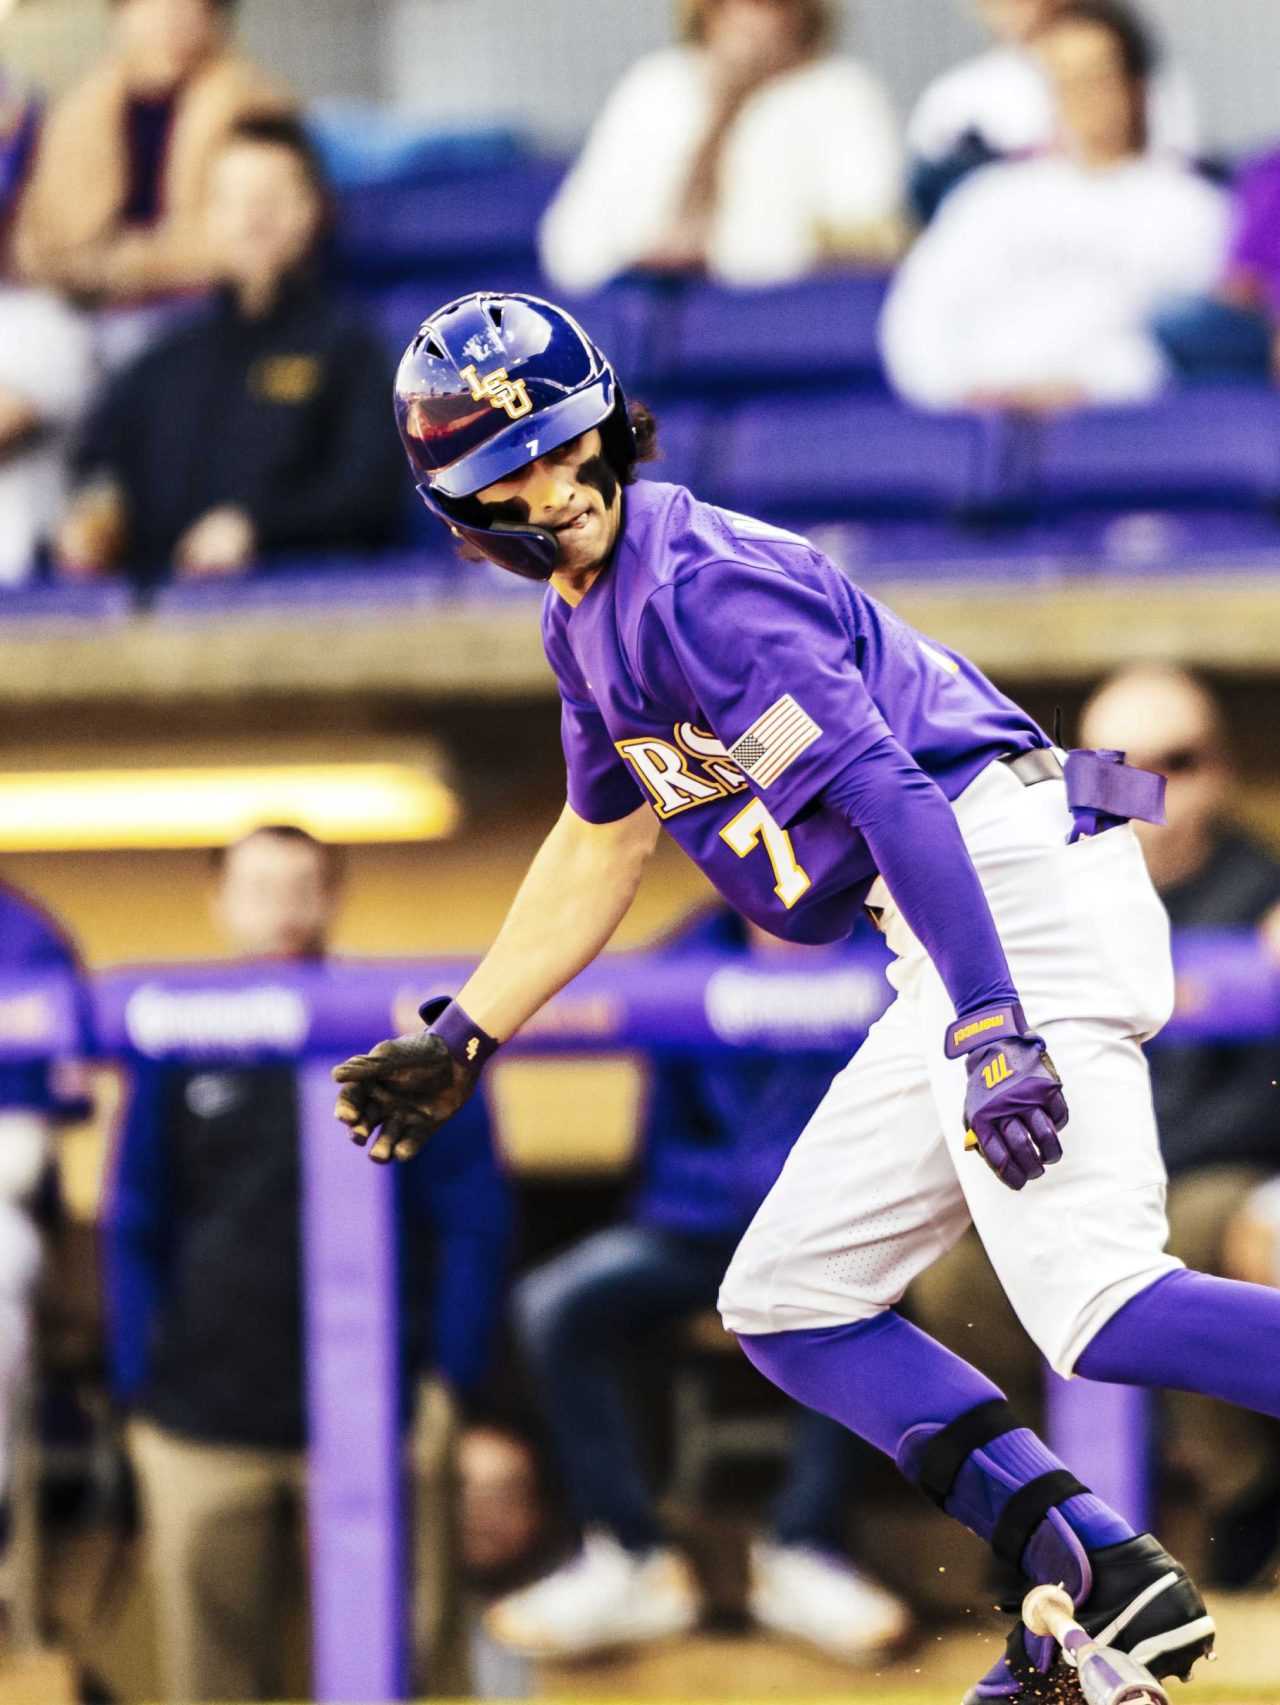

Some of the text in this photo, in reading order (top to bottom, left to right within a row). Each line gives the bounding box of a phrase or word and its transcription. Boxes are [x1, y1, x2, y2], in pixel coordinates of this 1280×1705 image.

[459, 363, 533, 420] LSU
[525, 439, 540, 457] 7
[718, 795, 814, 910] 7
